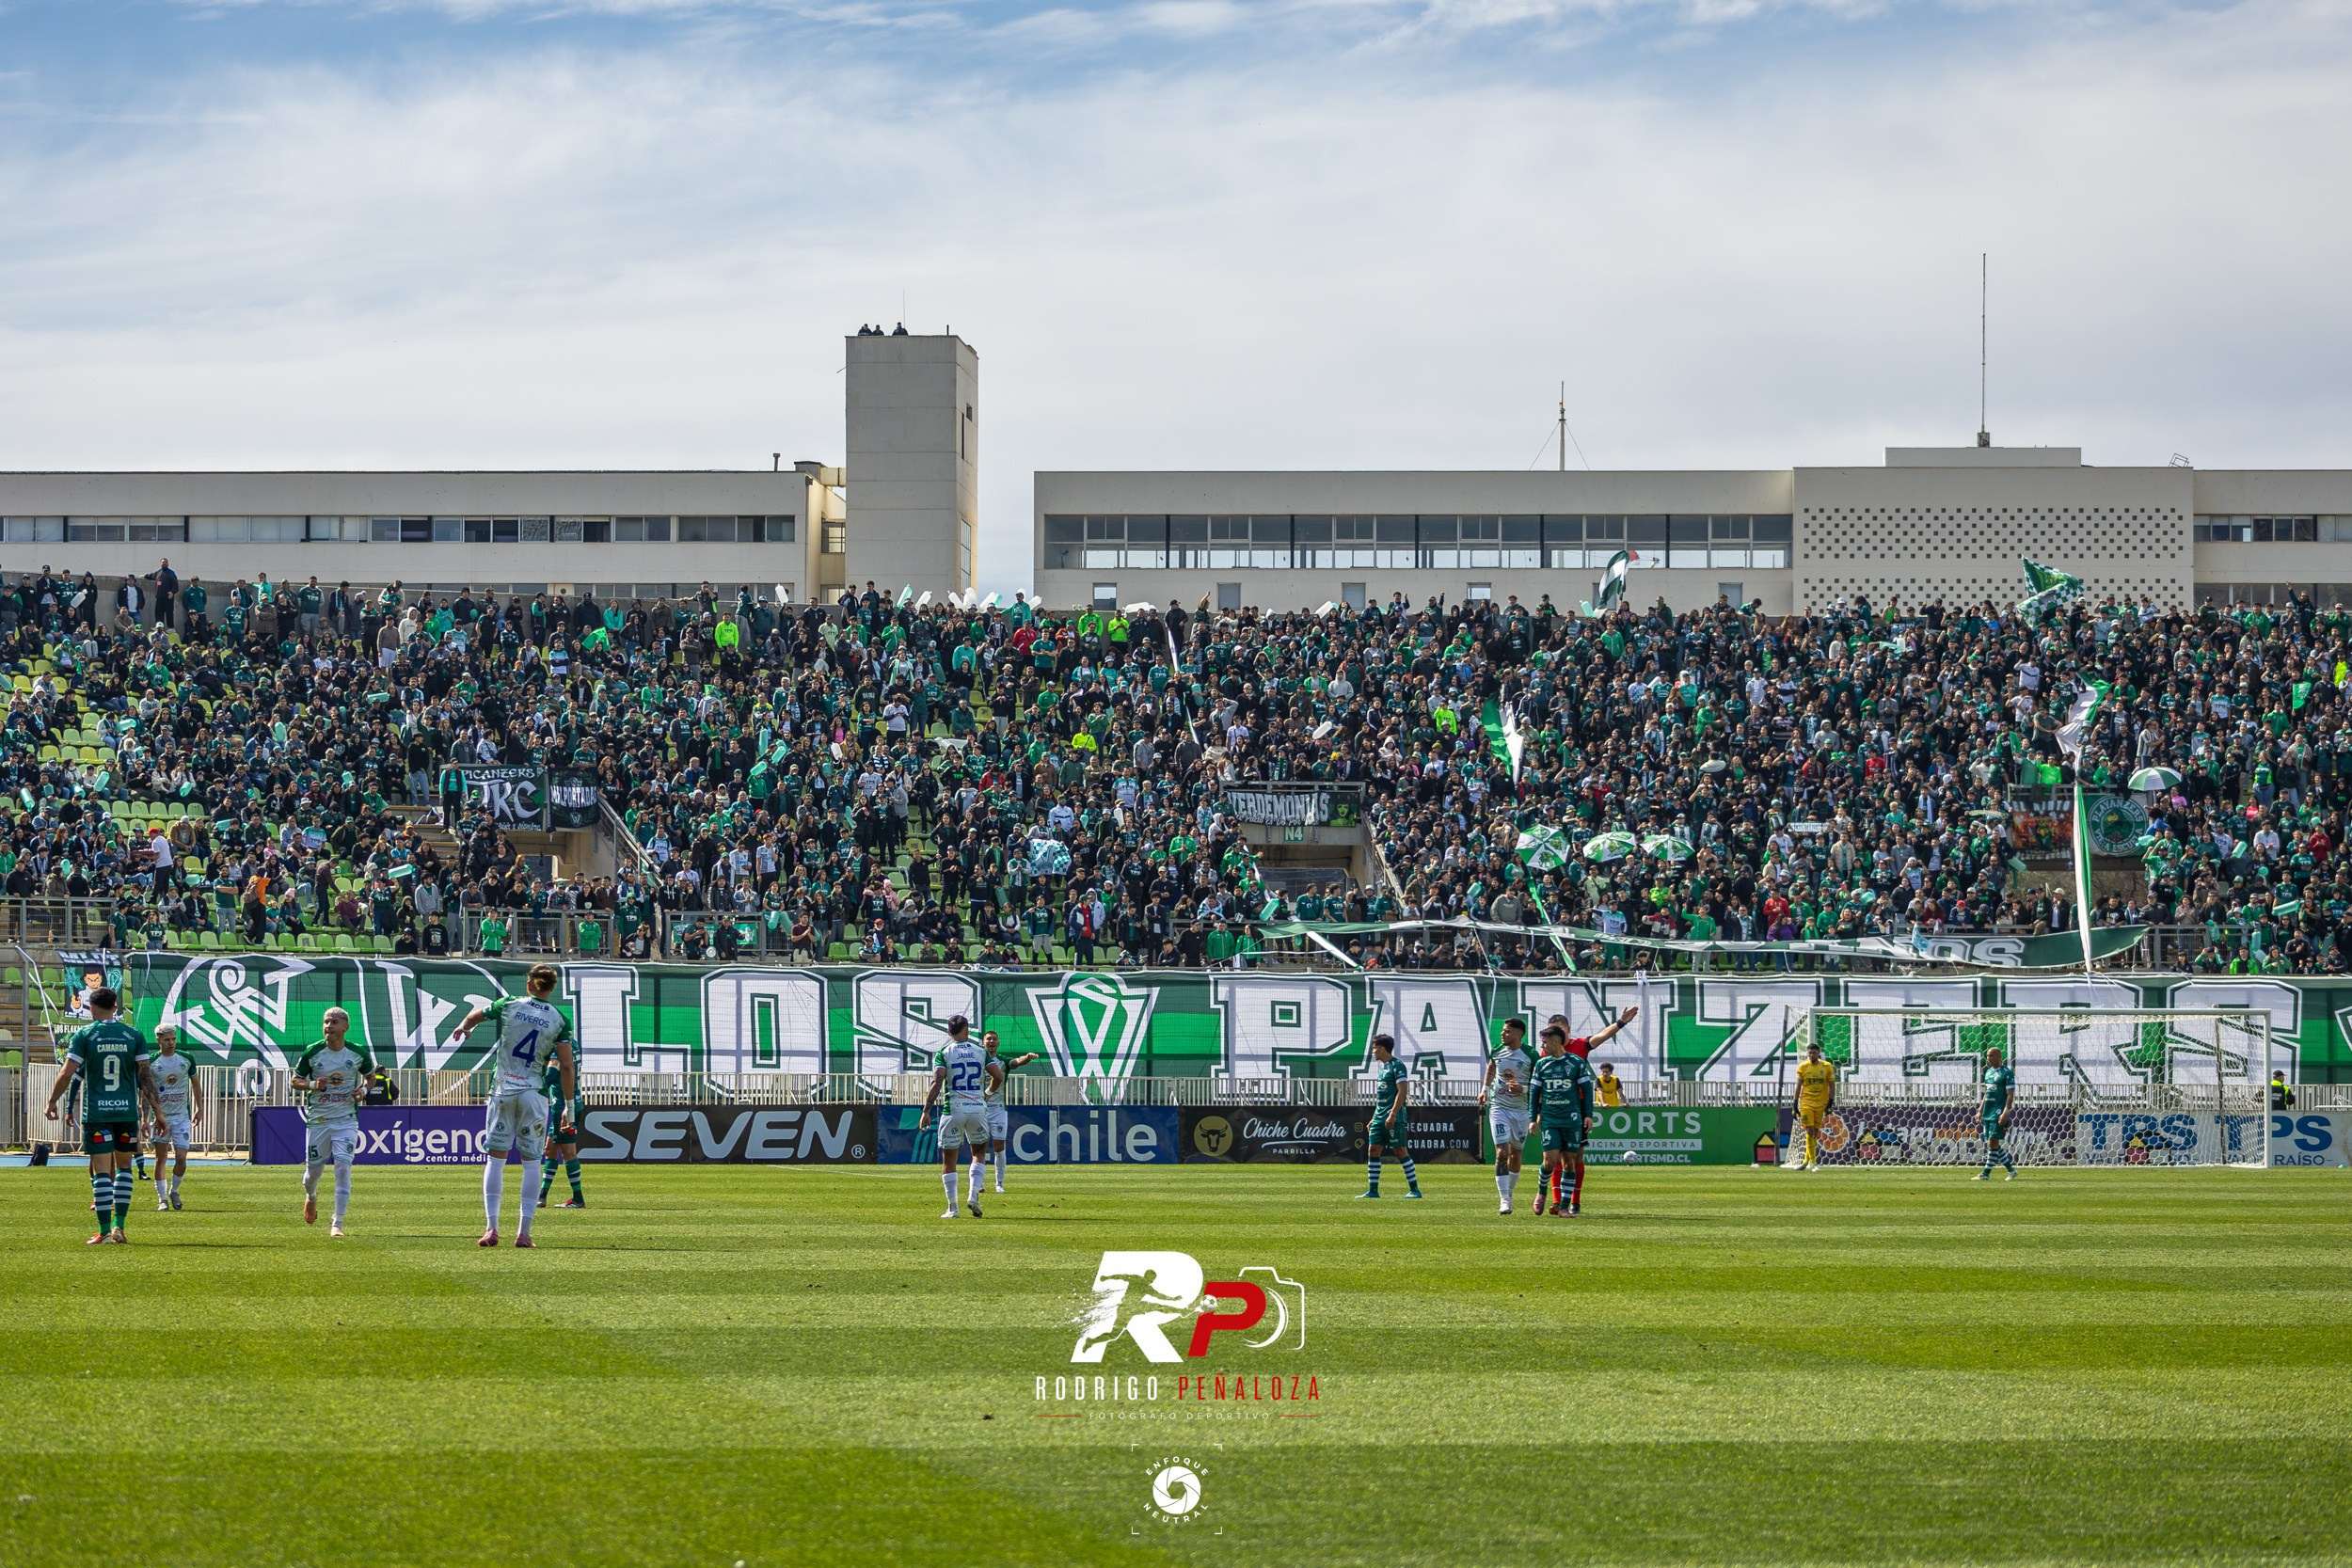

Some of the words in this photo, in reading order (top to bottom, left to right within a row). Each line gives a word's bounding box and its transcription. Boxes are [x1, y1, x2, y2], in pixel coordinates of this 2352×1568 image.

[2091, 799, 2144, 822] PLAYANZERS
[1285, 827, 1303, 840] N4
[514, 1011, 550, 1029] RIVEROS
[561, 961, 982, 1100] LOS
[1209, 972, 2303, 1104] PANZERS
[97, 1043, 128, 1053] CAMARDA
[512, 1028, 540, 1069] 4
[103, 1054, 120, 1091] 9
[951, 1061, 982, 1091] 22
[1545, 1079, 1572, 1089] TPS
[1243, 1117, 1289, 1139] Chiche
[1293, 1117, 1347, 1139] Cuadra
[1405, 1122, 1454, 1132] HECUADRA
[1496, 1123, 1505, 1135] 18
[1589, 1112, 1701, 1134] PORTS
[2077, 1114, 2198, 1151] TPS
[2215, 1115, 2333, 1152] TPS
[577, 1111, 853, 1159] SEVEN
[1012, 1110, 1157, 1162] chile
[1407, 1139, 1470, 1148] CUADRA.COM
[308, 1145, 318, 1159] 15
[461, 1154, 489, 1163] médi
